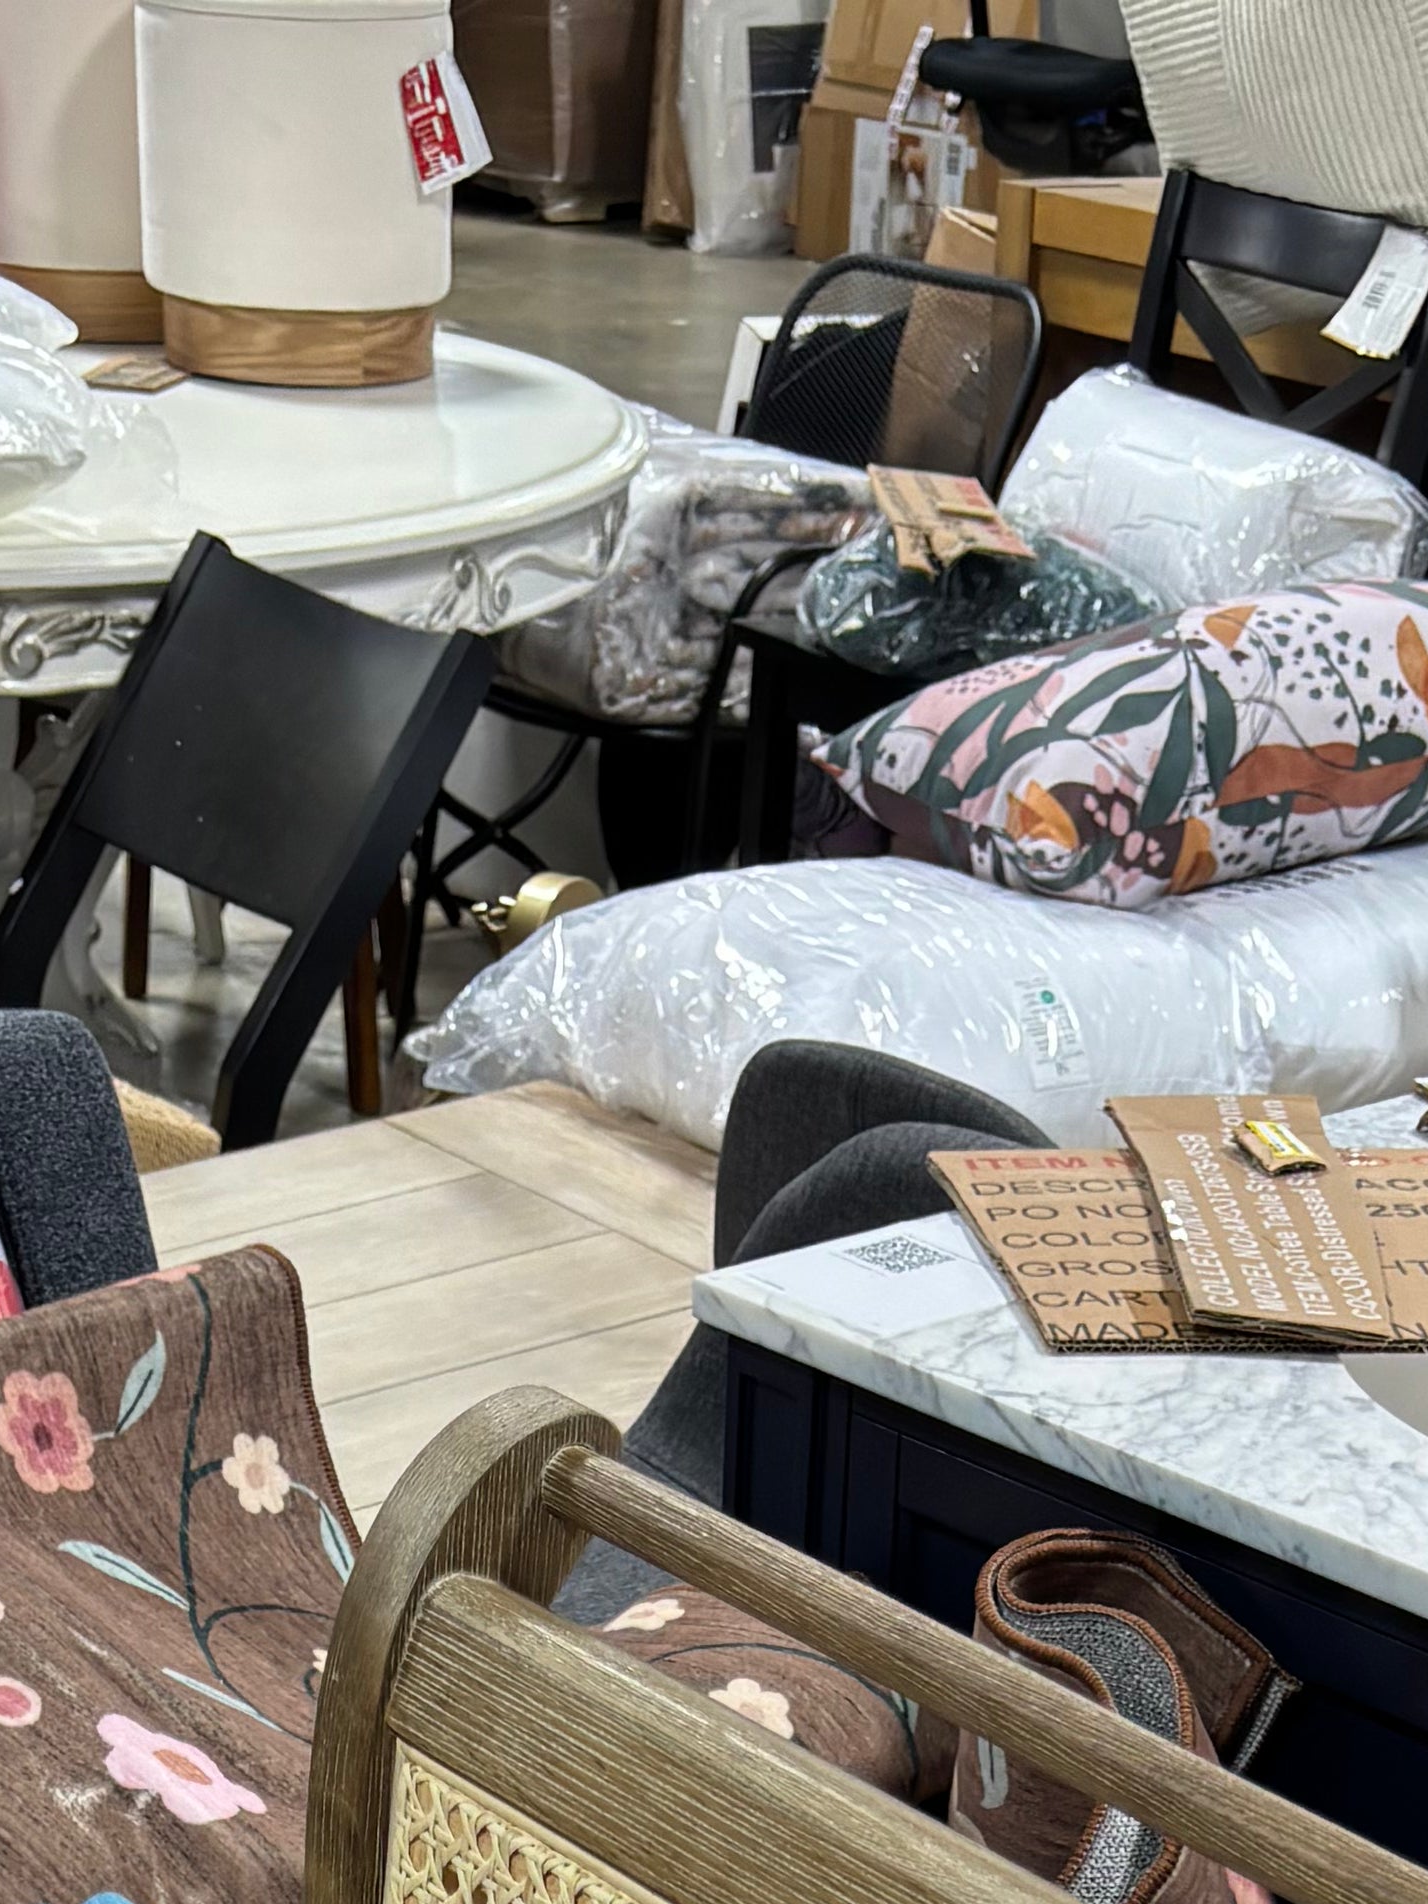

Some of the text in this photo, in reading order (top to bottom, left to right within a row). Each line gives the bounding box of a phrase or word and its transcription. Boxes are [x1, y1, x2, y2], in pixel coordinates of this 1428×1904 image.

[964, 1155, 1142, 1171] ITEM N
[970, 1178, 1150, 1196] DESCR
[985, 1204, 1059, 1222] PO
[1253, 1192, 1294, 1230] Table
[1016, 1259, 1174, 1277] GROS
[1241, 1263, 1290, 1312] MODEL
[1032, 1290, 1180, 1308] CART
